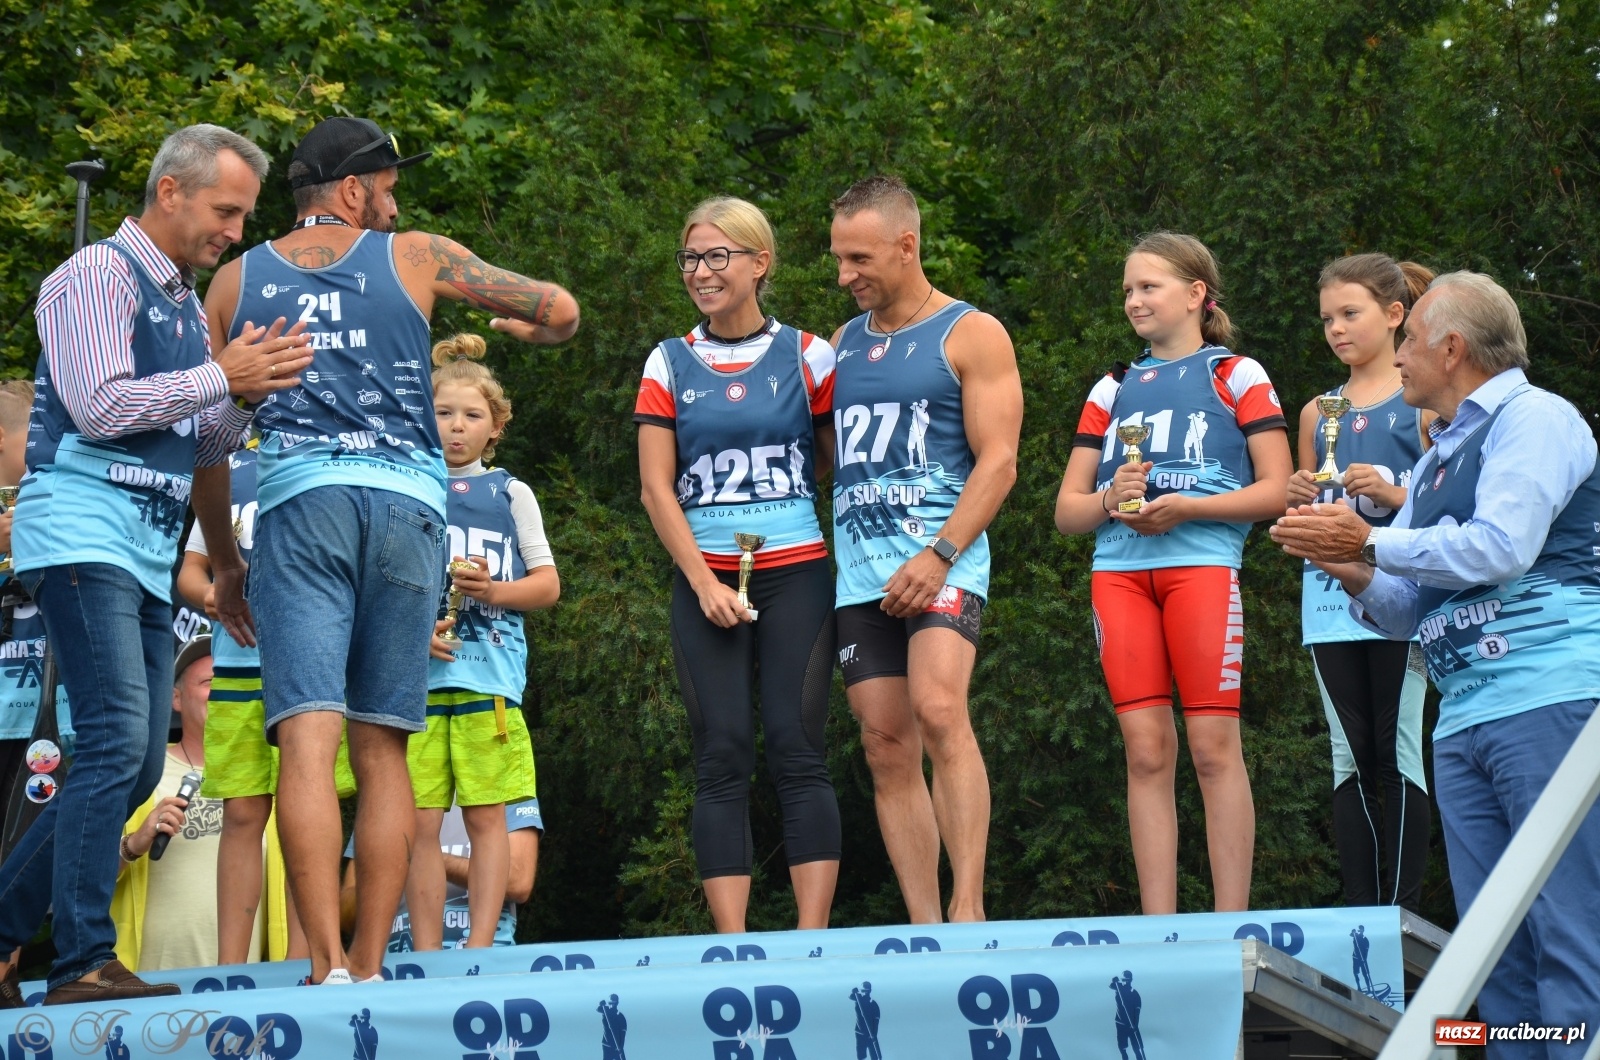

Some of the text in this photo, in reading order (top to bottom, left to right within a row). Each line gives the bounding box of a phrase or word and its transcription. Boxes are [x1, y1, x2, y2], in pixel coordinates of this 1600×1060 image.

[297, 291, 342, 323] 24
[348, 329, 367, 348] M
[109, 462, 166, 492] ODRA
[689, 443, 791, 506] 125
[1155, 472, 1199, 491] CUP
[701, 500, 797, 518] AQUA MARINA
[886, 484, 926, 506] CUP
[1316, 605, 1344, 613] AQUA
[1452, 599, 1503, 631] CUP
[1453, 673, 1499, 699] MARINA
[702, 985, 801, 1038] OD
[957, 973, 1060, 1026] OD
[453, 998, 550, 1051] OD
